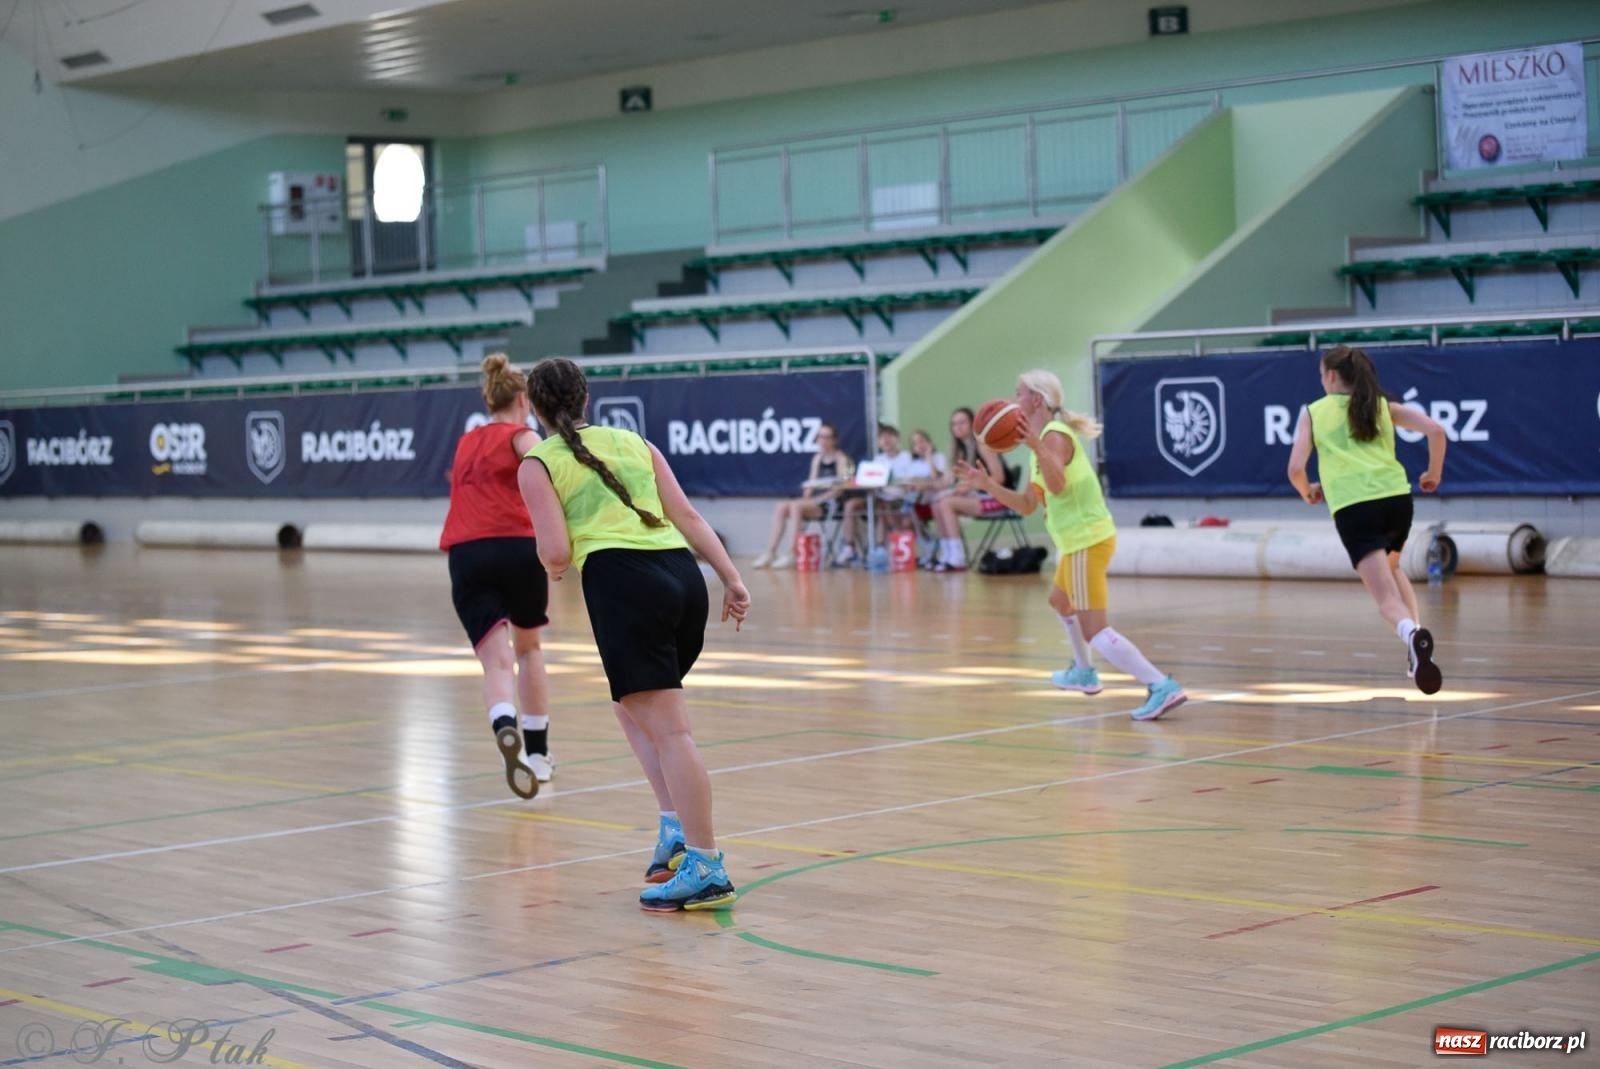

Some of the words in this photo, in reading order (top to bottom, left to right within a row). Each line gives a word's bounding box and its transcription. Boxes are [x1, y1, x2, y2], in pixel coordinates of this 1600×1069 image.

[1158, 15, 1180, 32] B
[1458, 50, 1566, 85] MIESZKO
[26, 427, 114, 466] RACIBÓRZ
[301, 419, 416, 463] RACIBÓRZ
[667, 406, 822, 455] RACIBÓRZ
[897, 533, 913, 562] 5
